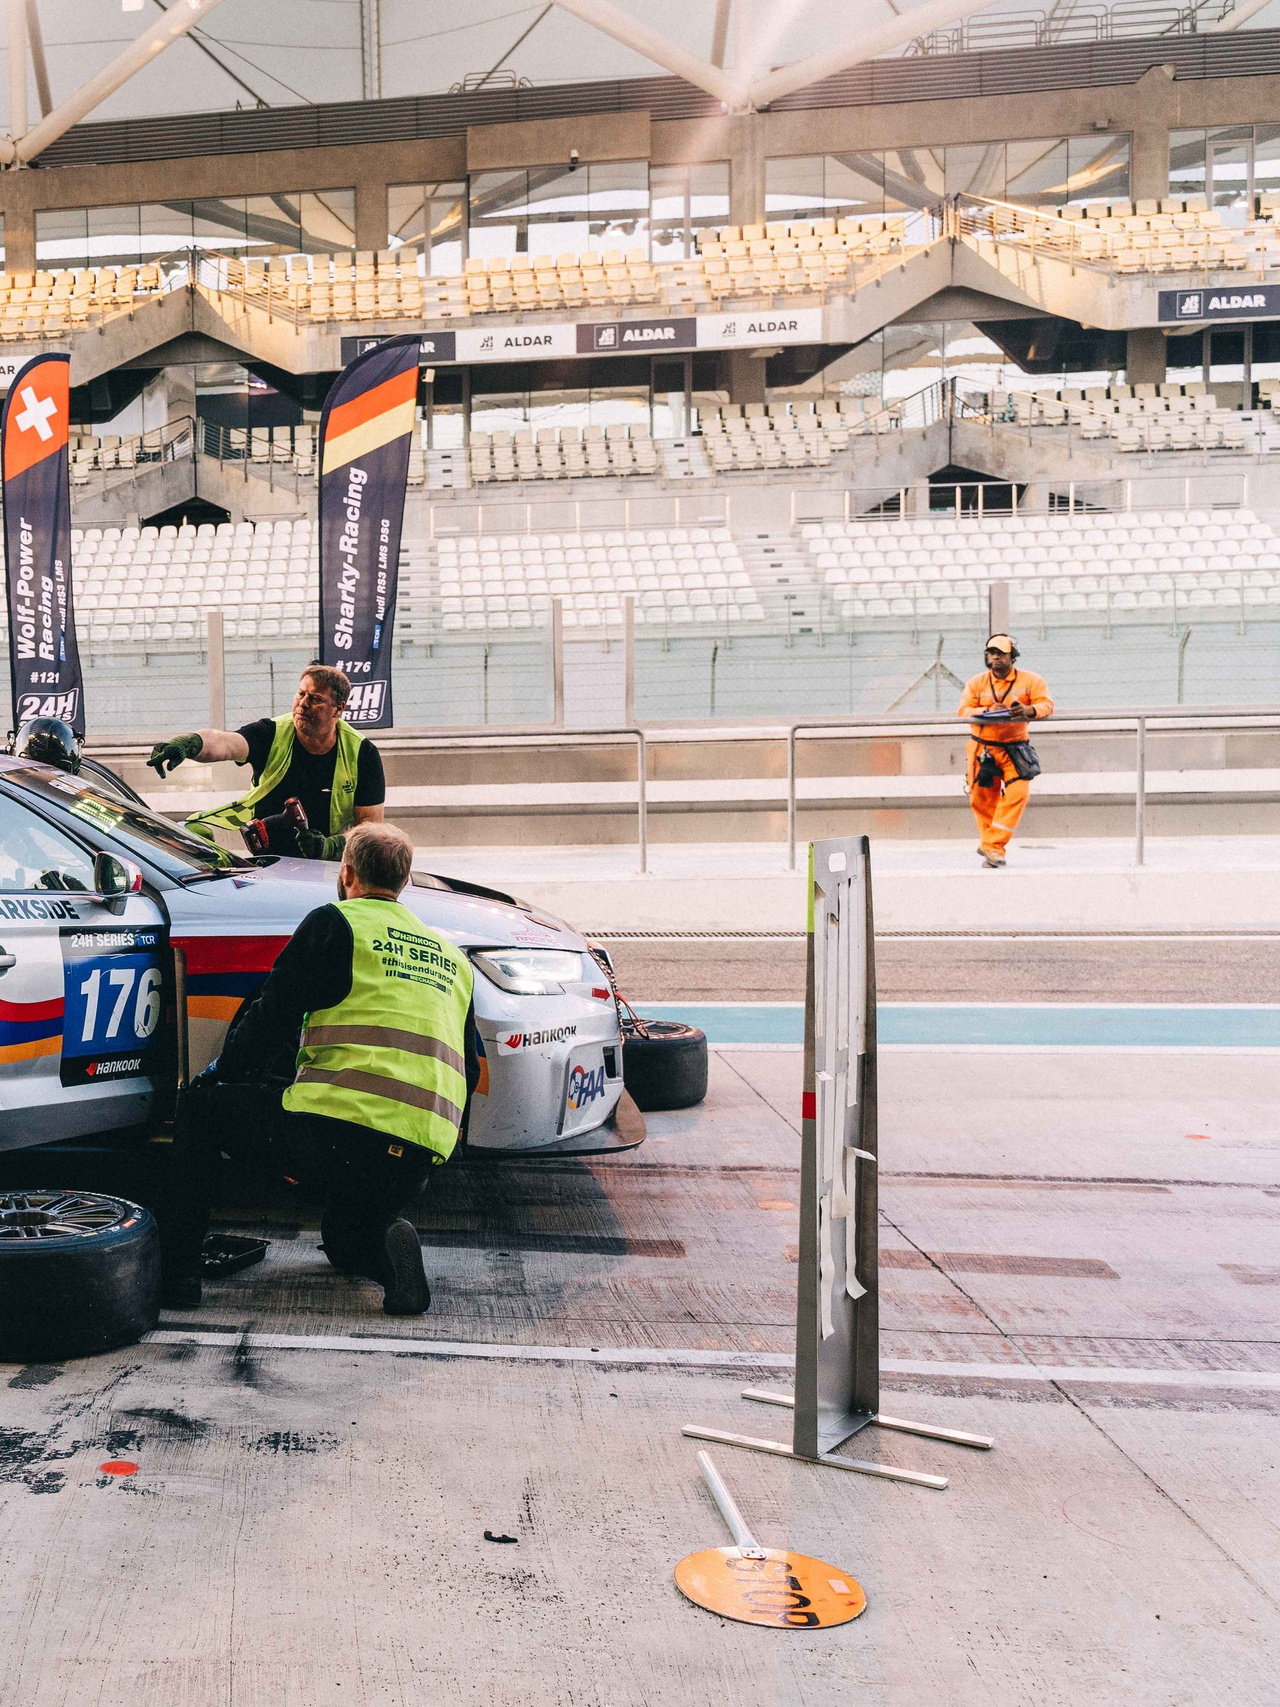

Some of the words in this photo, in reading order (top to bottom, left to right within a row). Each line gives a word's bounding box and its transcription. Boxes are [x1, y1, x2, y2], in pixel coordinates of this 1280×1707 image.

[1207, 294, 1266, 310] ALDAR
[622, 326, 676, 342] ALDAR
[747, 319, 798, 333] ALDAR
[504, 335, 553, 348] ALDAR
[381, 519, 391, 545] DSG
[334, 466, 368, 650] Sharky-Racing
[379, 547, 389, 571] LMS
[54, 559, 63, 582] LMS
[17, 517, 36, 660] Wolf-Power
[57, 585, 66, 608] RS3
[377, 573, 387, 597] RS3
[38, 575, 55, 661] Racing
[375, 598, 385, 621] Audi
[30, 671, 60, 684] #121
[335, 661, 371, 673] #176
[21, 692, 74, 721] 24H
[346, 685, 382, 710] 4H
[342, 708, 378, 721] RIES
[71, 934, 94, 948] 24H
[96, 932, 135, 947] SERIES
[141, 934, 156, 945] TCR
[372, 939, 403, 957] 24H
[409, 947, 457, 976] SERIES
[381, 957, 454, 986] #thisisendurance
[80, 967, 162, 1043] 176
[725, 1557, 820, 1627] STOP
